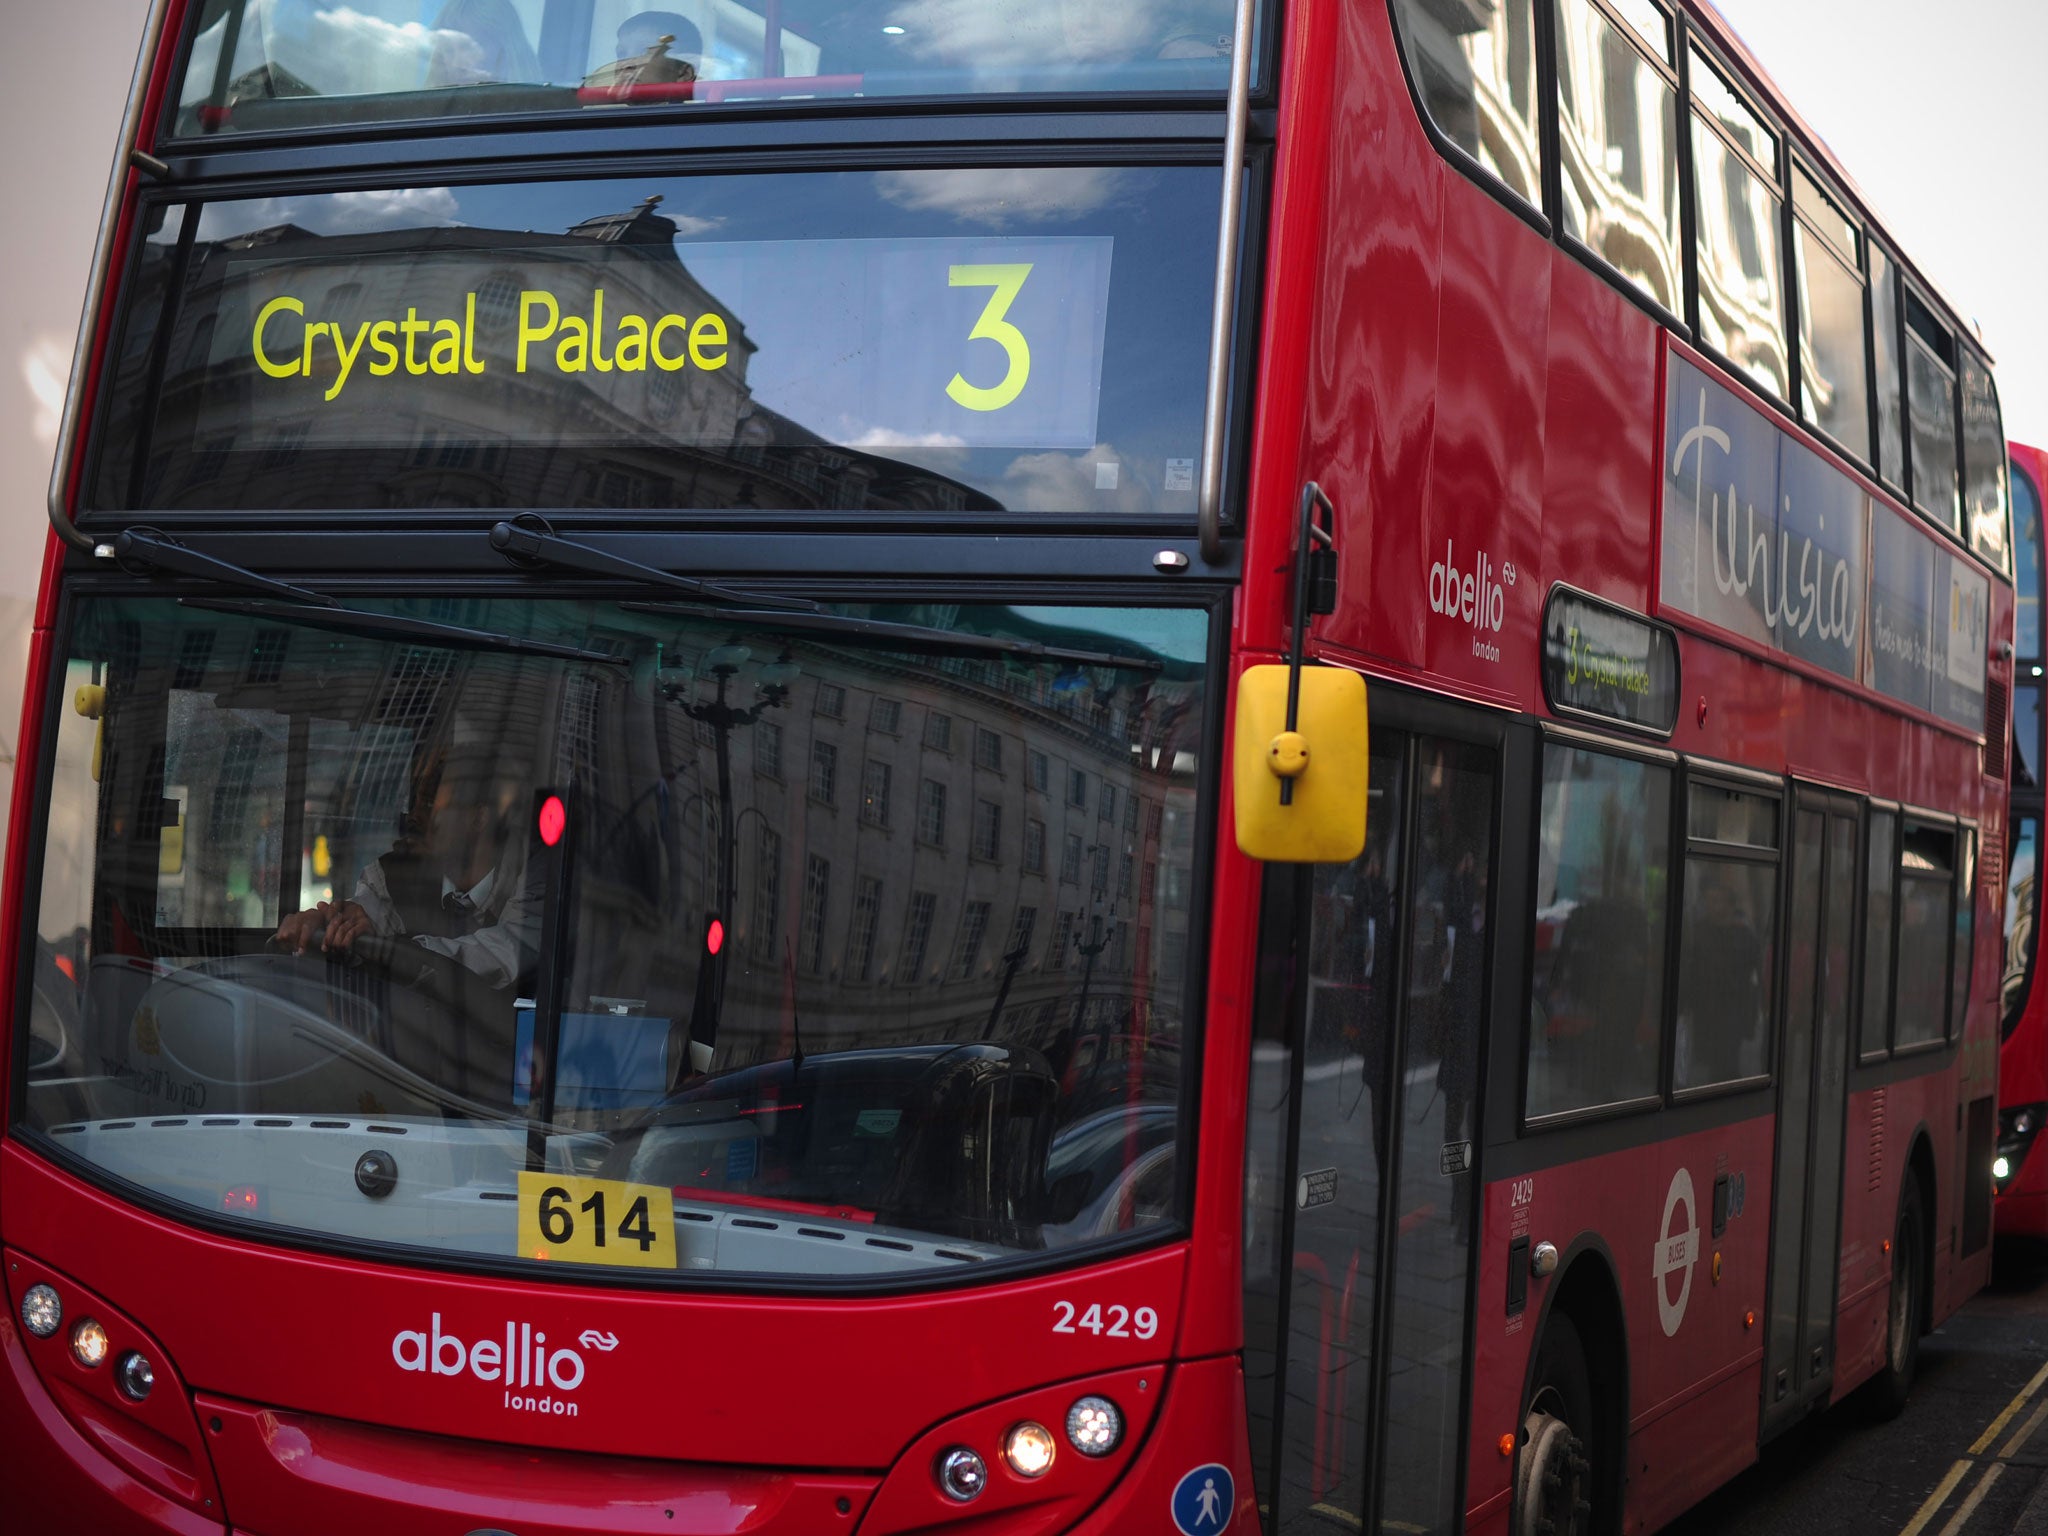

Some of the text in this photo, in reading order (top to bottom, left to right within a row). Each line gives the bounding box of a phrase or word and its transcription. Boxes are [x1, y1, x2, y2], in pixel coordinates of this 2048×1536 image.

[252, 288, 729, 402] Crystal Palace
[945, 262, 1034, 412] 3
[1673, 387, 1857, 648] Tunisia
[1429, 537, 1505, 633] abellio
[1472, 635, 1501, 664] london
[1567, 626, 1649, 697] 3 Crystal Palace
[539, 1186, 656, 1252] 614
[1511, 1178, 1534, 1208] 2429
[1667, 1240, 1686, 1265] BUSES
[392, 1312, 585, 1390] abellio
[1052, 1300, 1158, 1340] 2429
[504, 1390, 579, 1417] london
